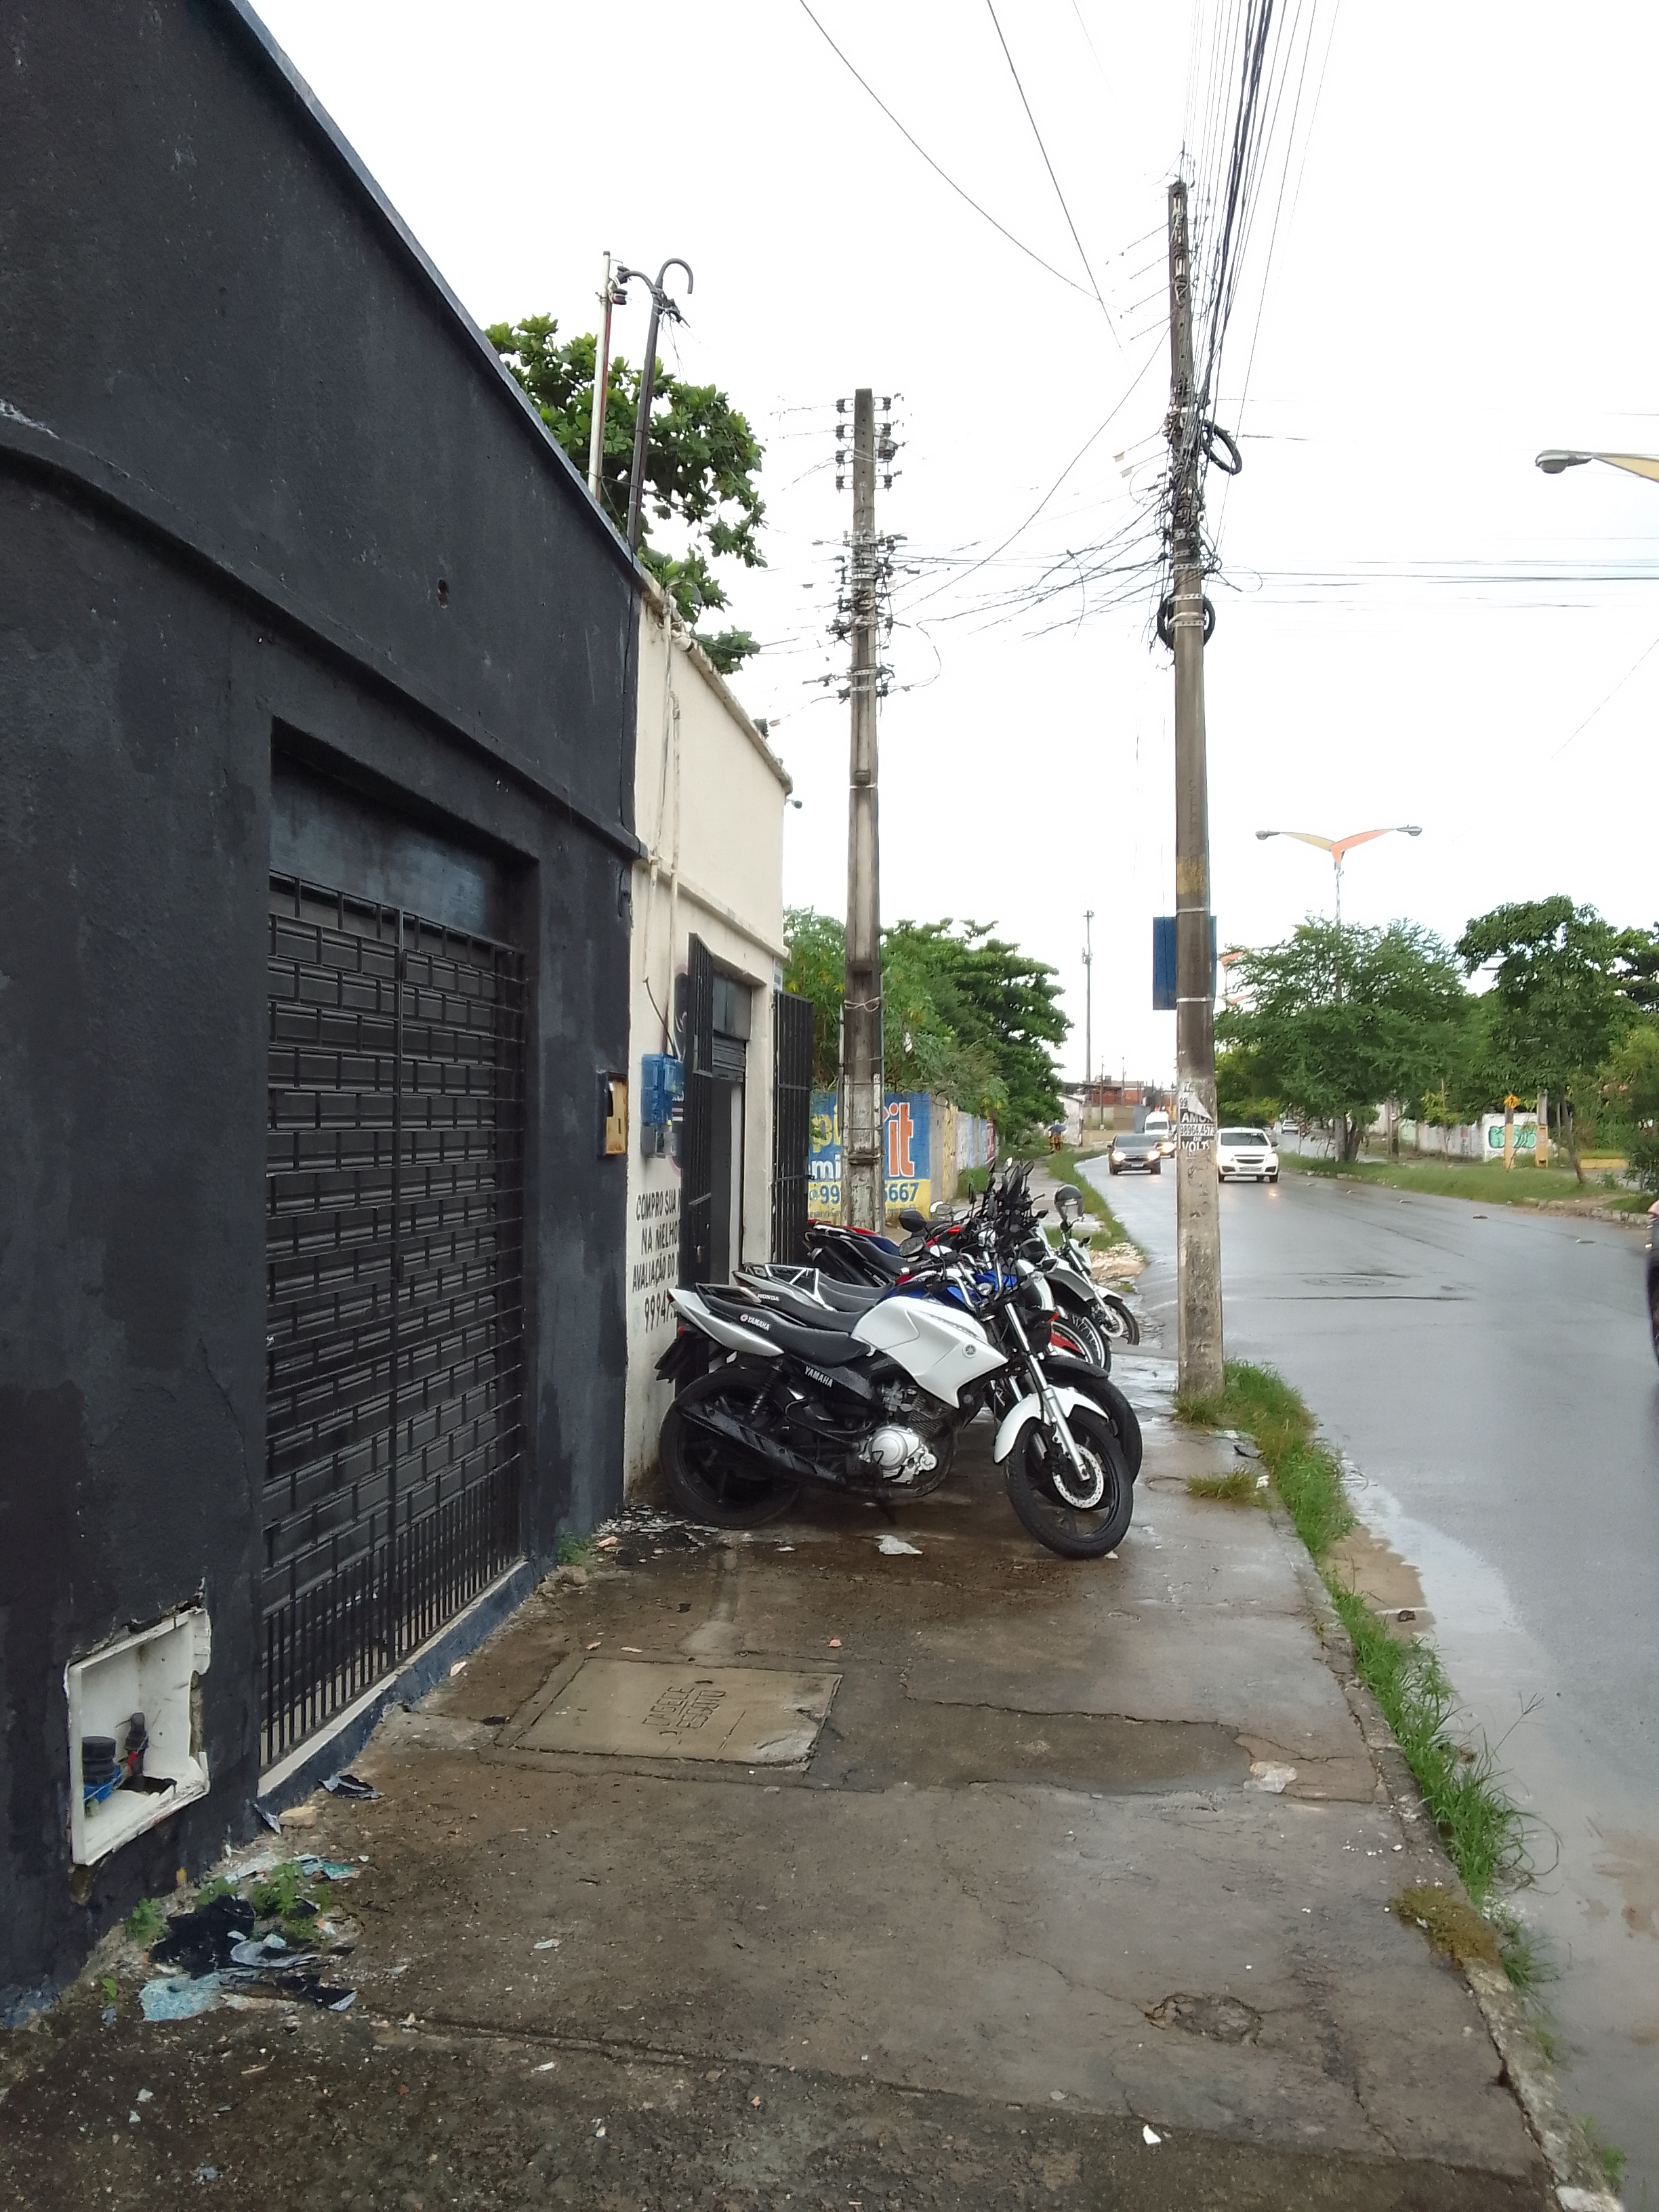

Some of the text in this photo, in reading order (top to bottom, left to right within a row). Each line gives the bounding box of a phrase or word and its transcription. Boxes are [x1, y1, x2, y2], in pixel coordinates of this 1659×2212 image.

[636, 1190, 663, 1221] COMPRO
[665, 1188, 676, 1216] SUA
[819, 1184, 840, 1204] 99
[641, 1220, 680, 1256] NA MELHO
[632, 1252, 665, 1293] AVALIAÇÃO
[668, 1252, 675, 1279] DO
[757, 1293, 780, 1302] HONDA
[747, 1316, 771, 1332] YAMAHA
[804, 1366, 834, 1388] YAMAHA
